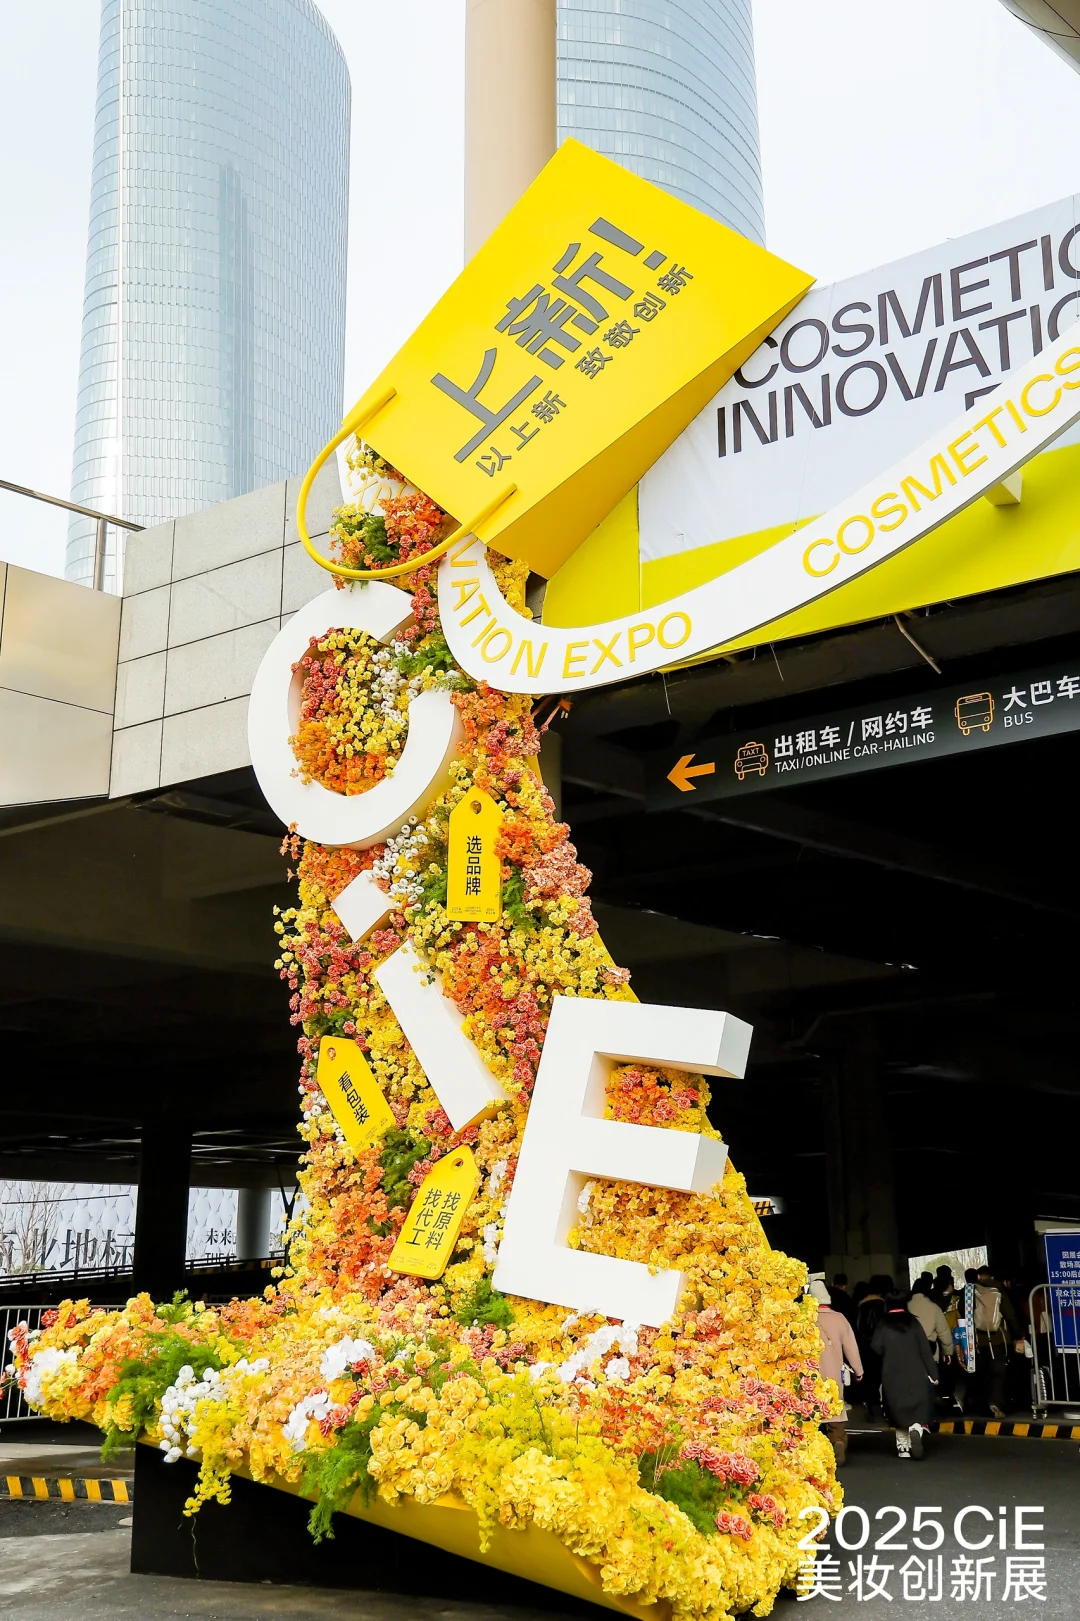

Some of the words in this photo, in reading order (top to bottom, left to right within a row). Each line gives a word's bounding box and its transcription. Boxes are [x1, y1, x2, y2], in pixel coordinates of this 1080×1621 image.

[475, 390, 567, 477] 以上新
[574, 263, 694, 380] 致敬创新
[562, 611, 692, 679] EXPO
[1003, 675, 1080, 712] 大巴车
[1003, 711, 1035, 728] BUS
[853, 731, 936, 758] CAR-HAILING
[465, 835, 483, 897] 选品牌
[337, 1070, 370, 1126] 看包装
[406, 1187, 441, 1246] 找代工
[424, 1191, 462, 1251] 找原料
